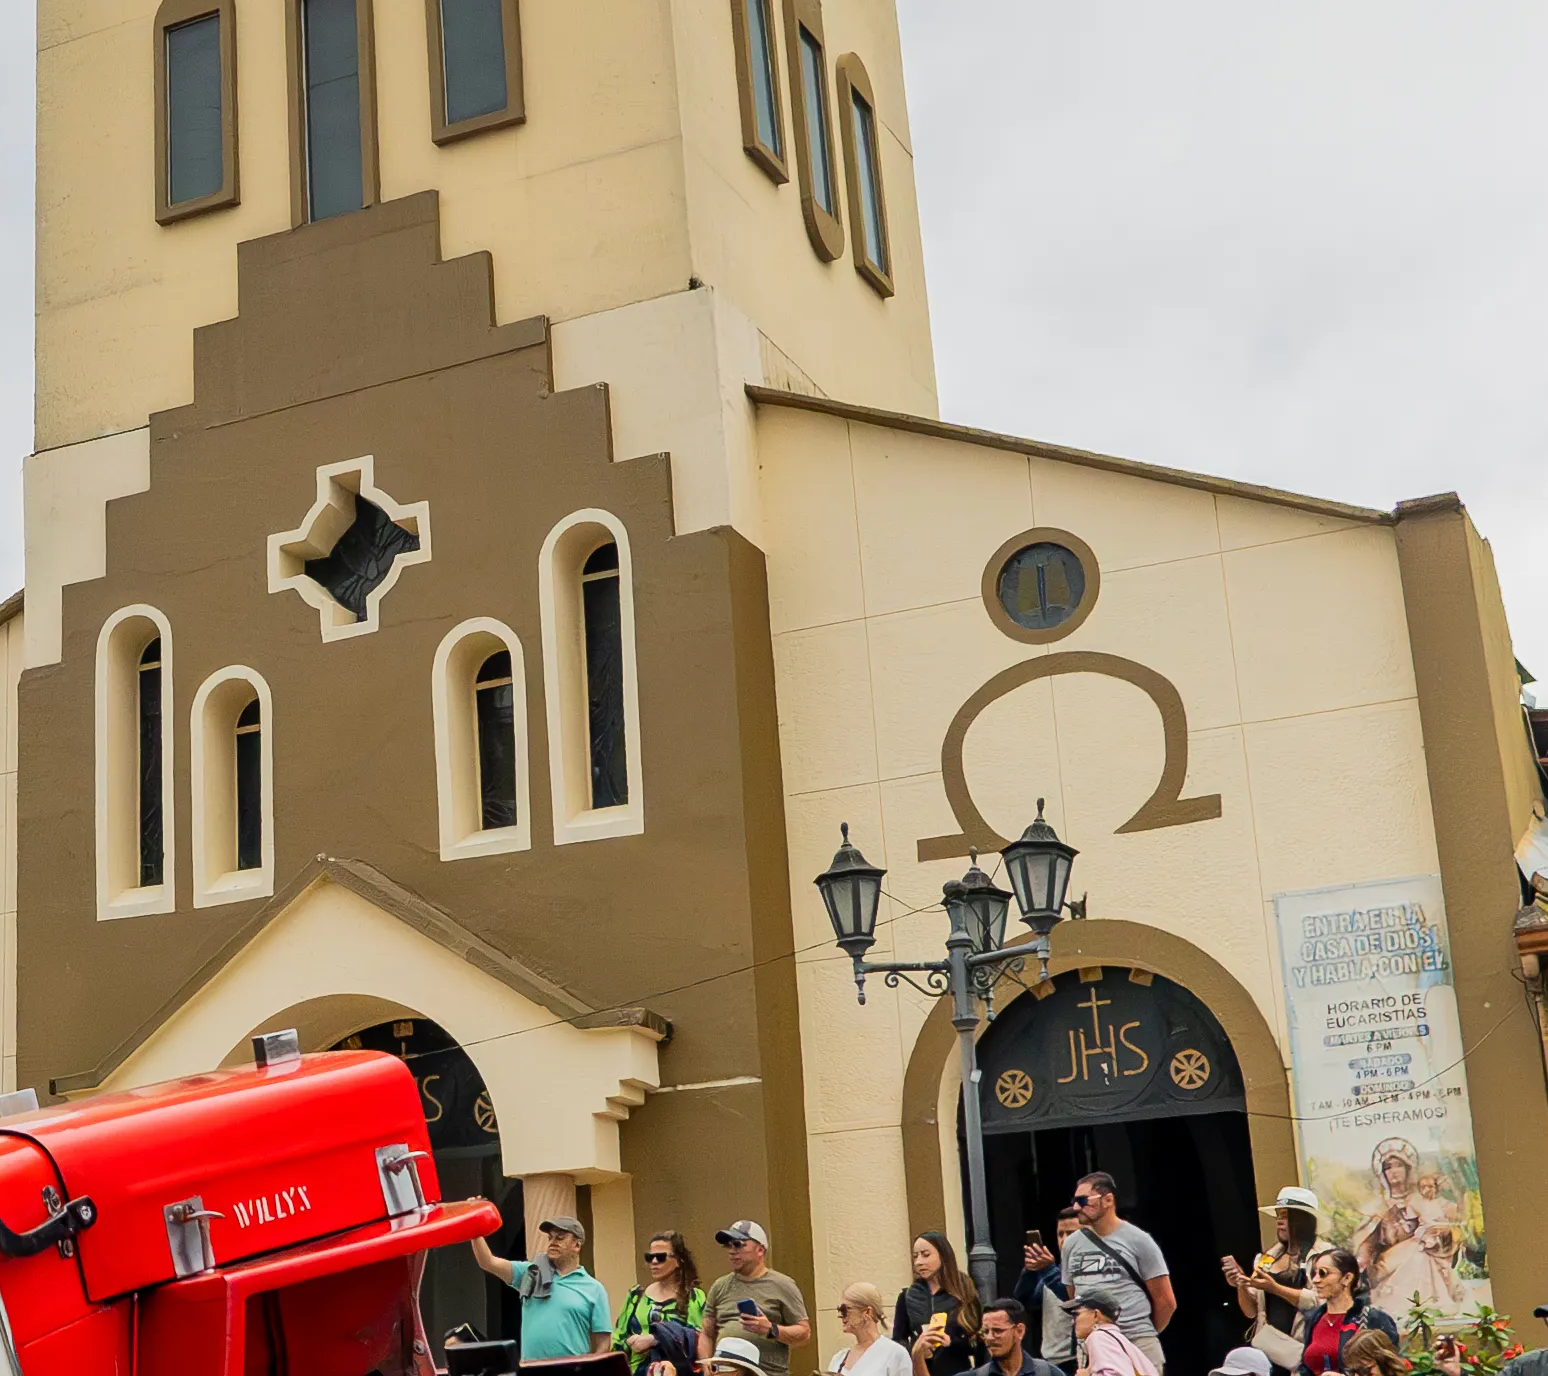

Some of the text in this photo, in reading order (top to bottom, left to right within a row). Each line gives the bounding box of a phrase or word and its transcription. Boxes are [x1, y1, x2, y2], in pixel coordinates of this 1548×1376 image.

[1303, 911, 1366, 938] ENTRA
[1301, 936, 1353, 962] CASA
[1354, 934, 1383, 956] DE
[1292, 967, 1306, 988] Y
[1309, 957, 1373, 986] HABLA
[1378, 953, 1418, 977] CON
[1327, 993, 1422, 1015] HORARIO DE
[1326, 1007, 1427, 1029] EUCARISTIAS
[1376, 1042, 1392, 1051] PM
[1364, 1070, 1378, 1078] PM
[1395, 1066, 1409, 1076] PM
[233, 1186, 311, 1229] WILLYS
